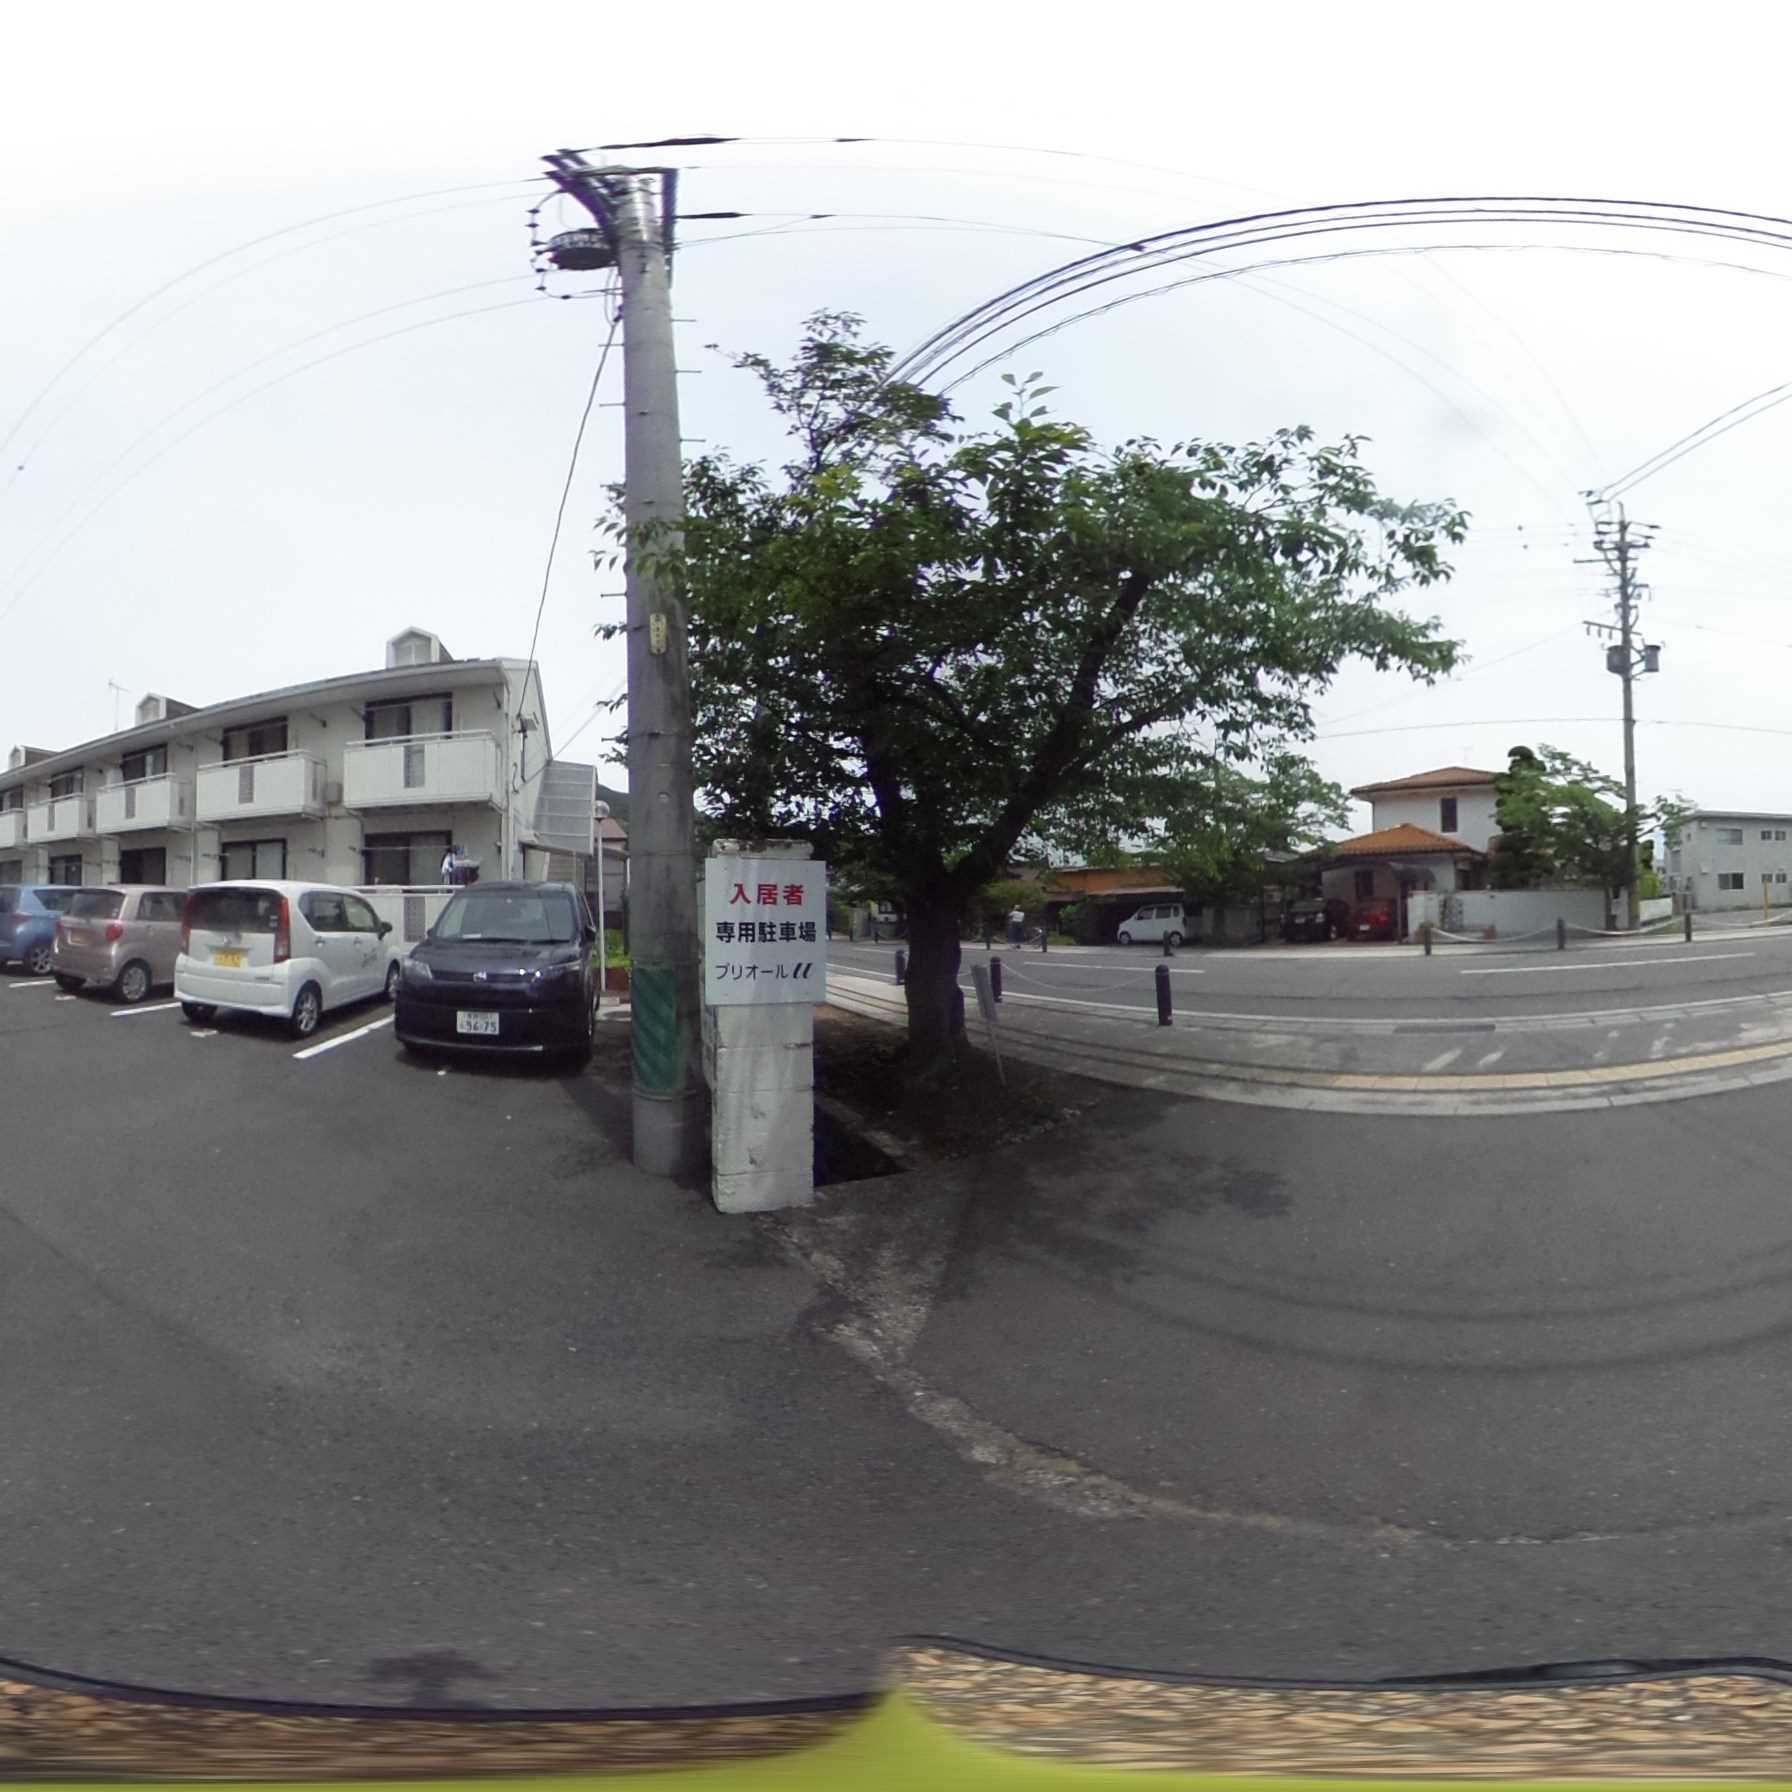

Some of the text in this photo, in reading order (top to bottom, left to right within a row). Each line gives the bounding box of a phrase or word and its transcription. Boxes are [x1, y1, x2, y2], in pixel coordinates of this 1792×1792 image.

[730, 883, 804, 906] 入居者
[715, 921, 817, 943] 専用駐車場
